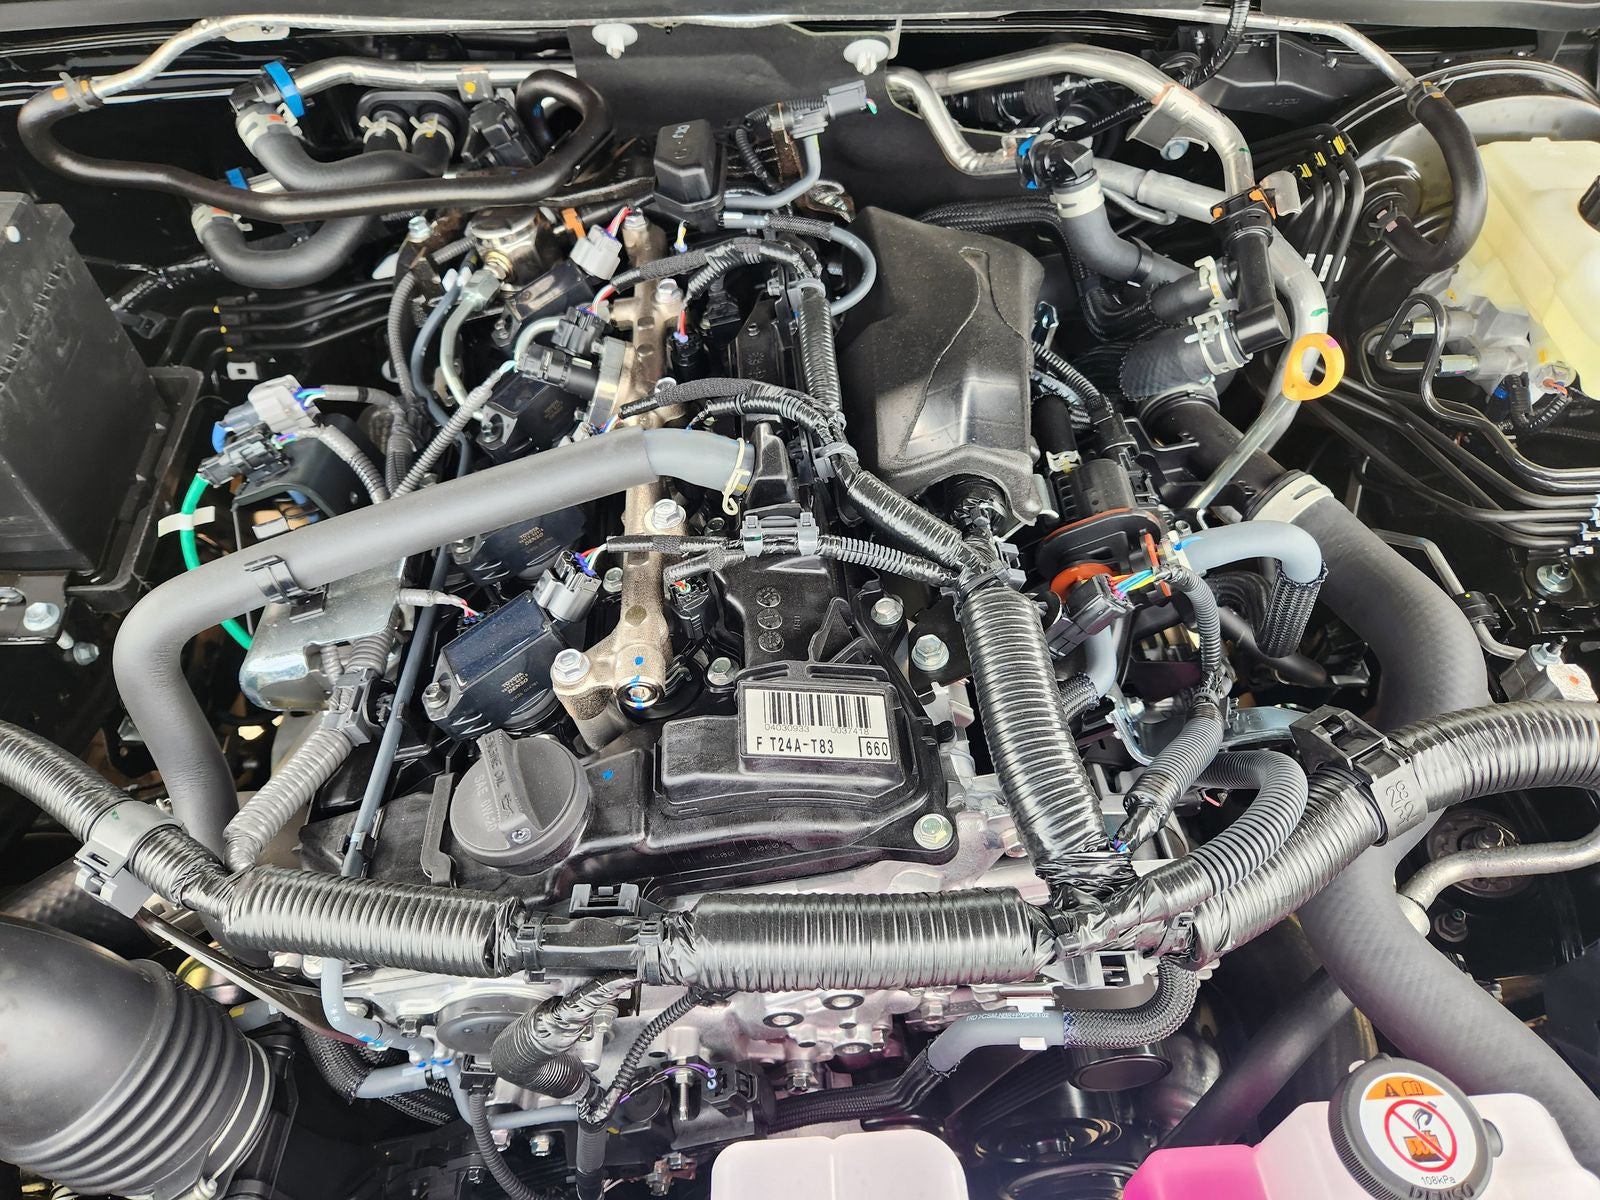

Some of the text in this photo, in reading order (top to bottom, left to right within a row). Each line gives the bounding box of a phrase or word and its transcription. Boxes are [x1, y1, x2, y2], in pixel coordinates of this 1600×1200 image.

[501, 672, 525, 687] TOYOTA
[508, 678, 529, 694] DENSO
[764, 723, 870, 736] 04030933 0037418
[756, 736, 888, 757] F T24A-T83 660
[484, 736, 507, 789] ENGINE OIL
[1385, 779, 1409, 808] 28
[474, 774, 498, 833] SAE 0W-20
[1421, 1174, 1457, 1186] 108kPa
[1409, 1182, 1475, 1200] DENSO
